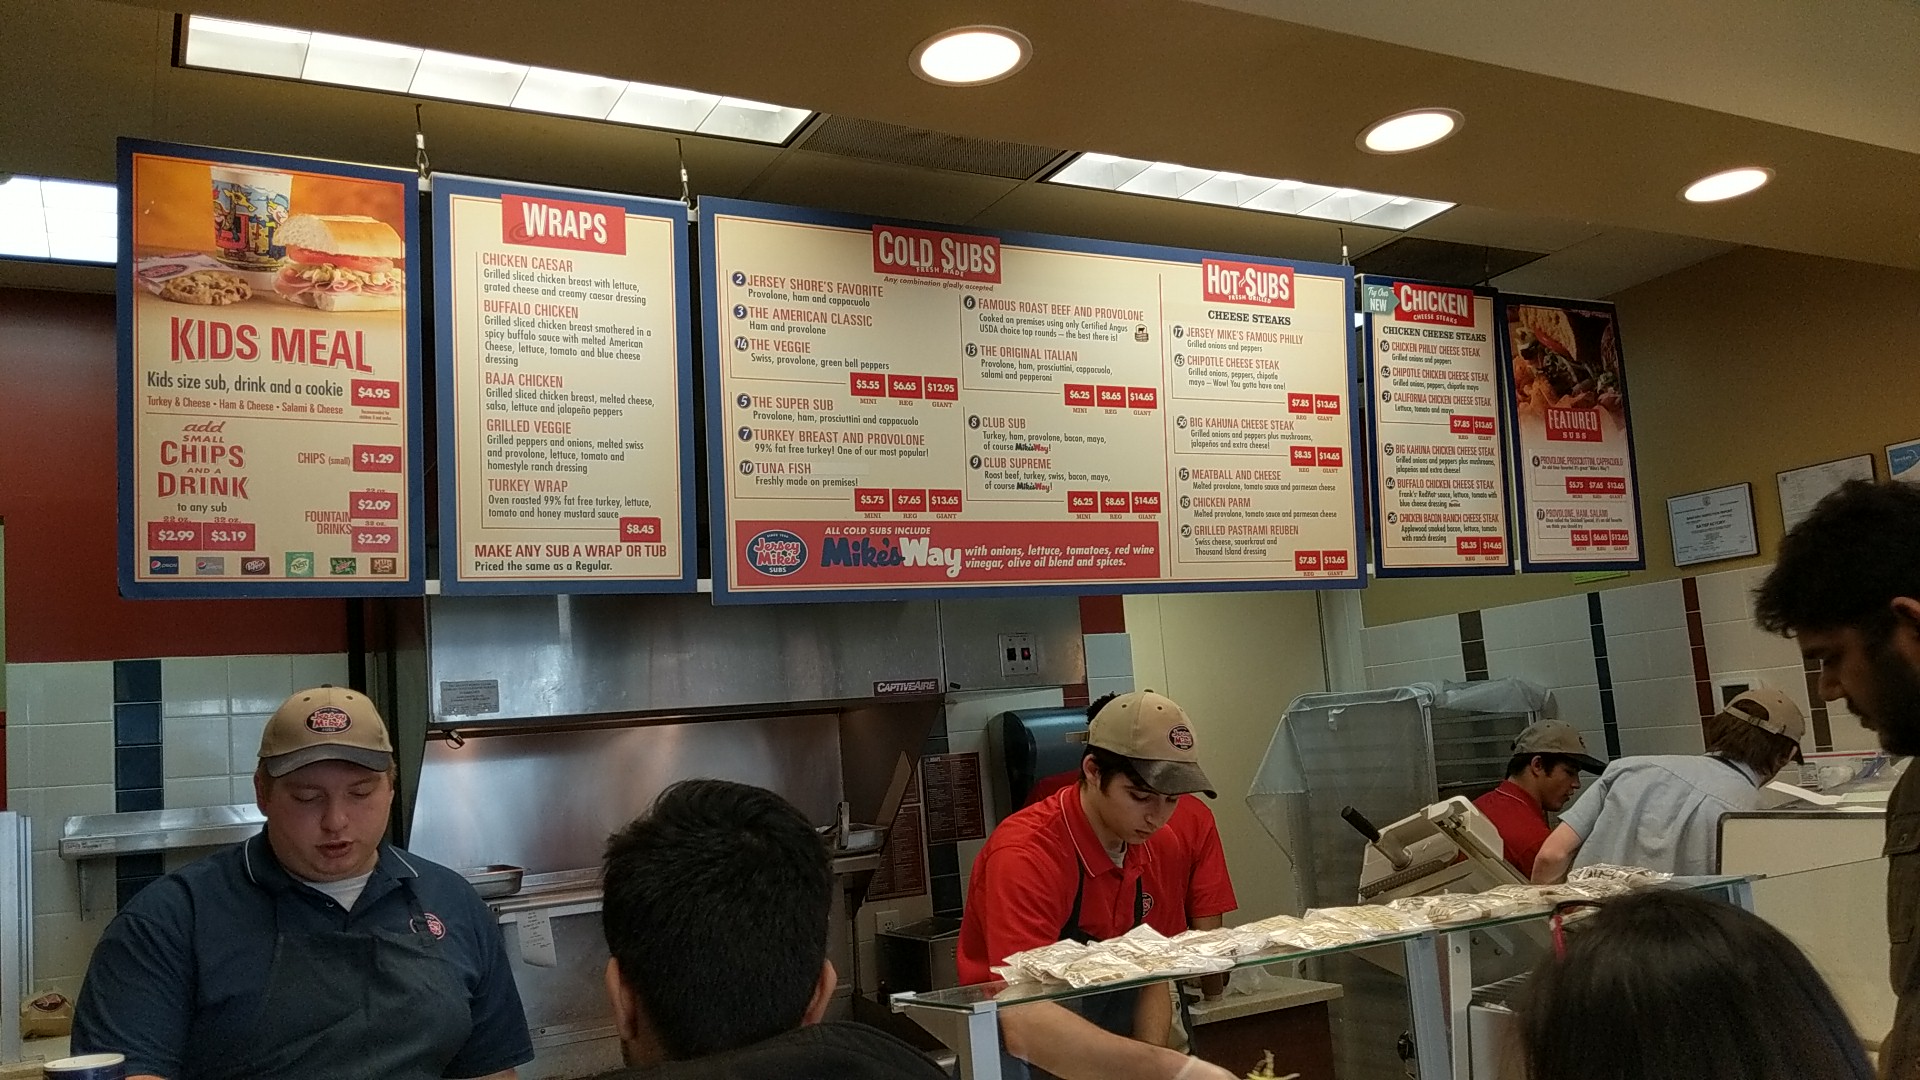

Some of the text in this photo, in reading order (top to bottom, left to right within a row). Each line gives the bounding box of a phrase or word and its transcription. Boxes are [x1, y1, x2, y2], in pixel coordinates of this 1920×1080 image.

[522, 202, 608, 244] WRAPS
[879, 230, 996, 274] COLD SUBS
[482, 253, 573, 272] CHICKEN CAESAR
[483, 269, 640, 292] Grilled sliced chicken breast with lettuce,
[747, 275, 883, 297] JERSEY SHORE'S FAVORITE
[884, 276, 898, 284] Any
[899, 278, 940, 287] combination
[942, 282, 963, 290] gladly
[1208, 264, 1290, 300] HOT SUBS
[1368, 287, 1376, 297] Try
[1370, 298, 1387, 311] NEW
[1401, 285, 1468, 318] CHICKEN
[484, 300, 579, 319] BUFFALO CHICKEN
[748, 307, 872, 326] THE AMERICAN CLASSIC
[978, 298, 1144, 321] FAMOUS ROAST BEEF AND PROVOLONE
[1208, 310, 1291, 325] CHEESE STEAKS
[1436, 315, 1457, 324] STEAKS
[1186, 328, 1303, 344] JERSEY MIKE'S FAMOUS PHILLY
[1383, 326, 1486, 342] CHICKEN CHEESE STEAKS
[171, 317, 373, 373] KIDS MEAL
[750, 339, 811, 353] THE VEGGIE
[980, 345, 1078, 361] THE ORIGINAL ITALIAN
[1188, 356, 1280, 370] CHIPOTLE CHEESE STEAK
[148, 371, 343, 396] Kids size sub, drink and a cookie
[485, 372, 563, 388] BAJA CHICKEN
[856, 380, 954, 393] $5.55 $6.65 $12.95
[358, 387, 391, 399] $4.95
[752, 396, 833, 411] THE SUPER SUB
[182, 421, 227, 433] add
[487, 419, 571, 434] GRILLED VEGGIE
[982, 417, 1026, 429] CLUB SUB
[1548, 409, 1598, 431] FEATURED
[182, 435, 225, 443] SMALL
[753, 429, 925, 445] TURKEY BREAST AND PROVOLONE
[160, 440, 244, 467] CHIPS
[297, 452, 325, 465] CHIPS
[361, 454, 394, 464] $1.29
[755, 463, 811, 474] TUNA FISH
[984, 458, 1051, 469] CLUB SUPREME
[1192, 470, 1281, 480] MEATBALL AND CHEESE
[157, 471, 249, 500] DRINK
[488, 479, 568, 492] TURKEY WRAP
[358, 500, 391, 511] $2.09
[860, 495, 958, 505] $5.75 $7.65 $13.65
[177, 503, 227, 514] to any sub
[305, 511, 351, 523] FOUNTAIN
[158, 530, 247, 542] $2.99 $3.19
[317, 523, 352, 535] DRINKS
[626, 524, 654, 534] $8.45
[825, 527, 931, 535] ALL COLD SUBS INCLUDE
[1194, 525, 1299, 535] GRILLED PASTRAMI REUBEN
[358, 534, 391, 544] $2.29
[475, 544, 666, 557] MAKE ANY SUB A WRAP OR TUB
[754, 538, 800, 556] Jersey
[965, 544, 1155, 557] with onions, lettuce, tomatoes, red wine
[756, 551, 800, 566] Mike's
[821, 537, 962, 577] Mike's Way
[965, 556, 1127, 570] vinegar, olive oil blend and spices.
[475, 561, 504, 571] Priced
[507, 561, 522, 571] the
[525, 563, 551, 571] same
[575, 561, 612, 572] Regular.
